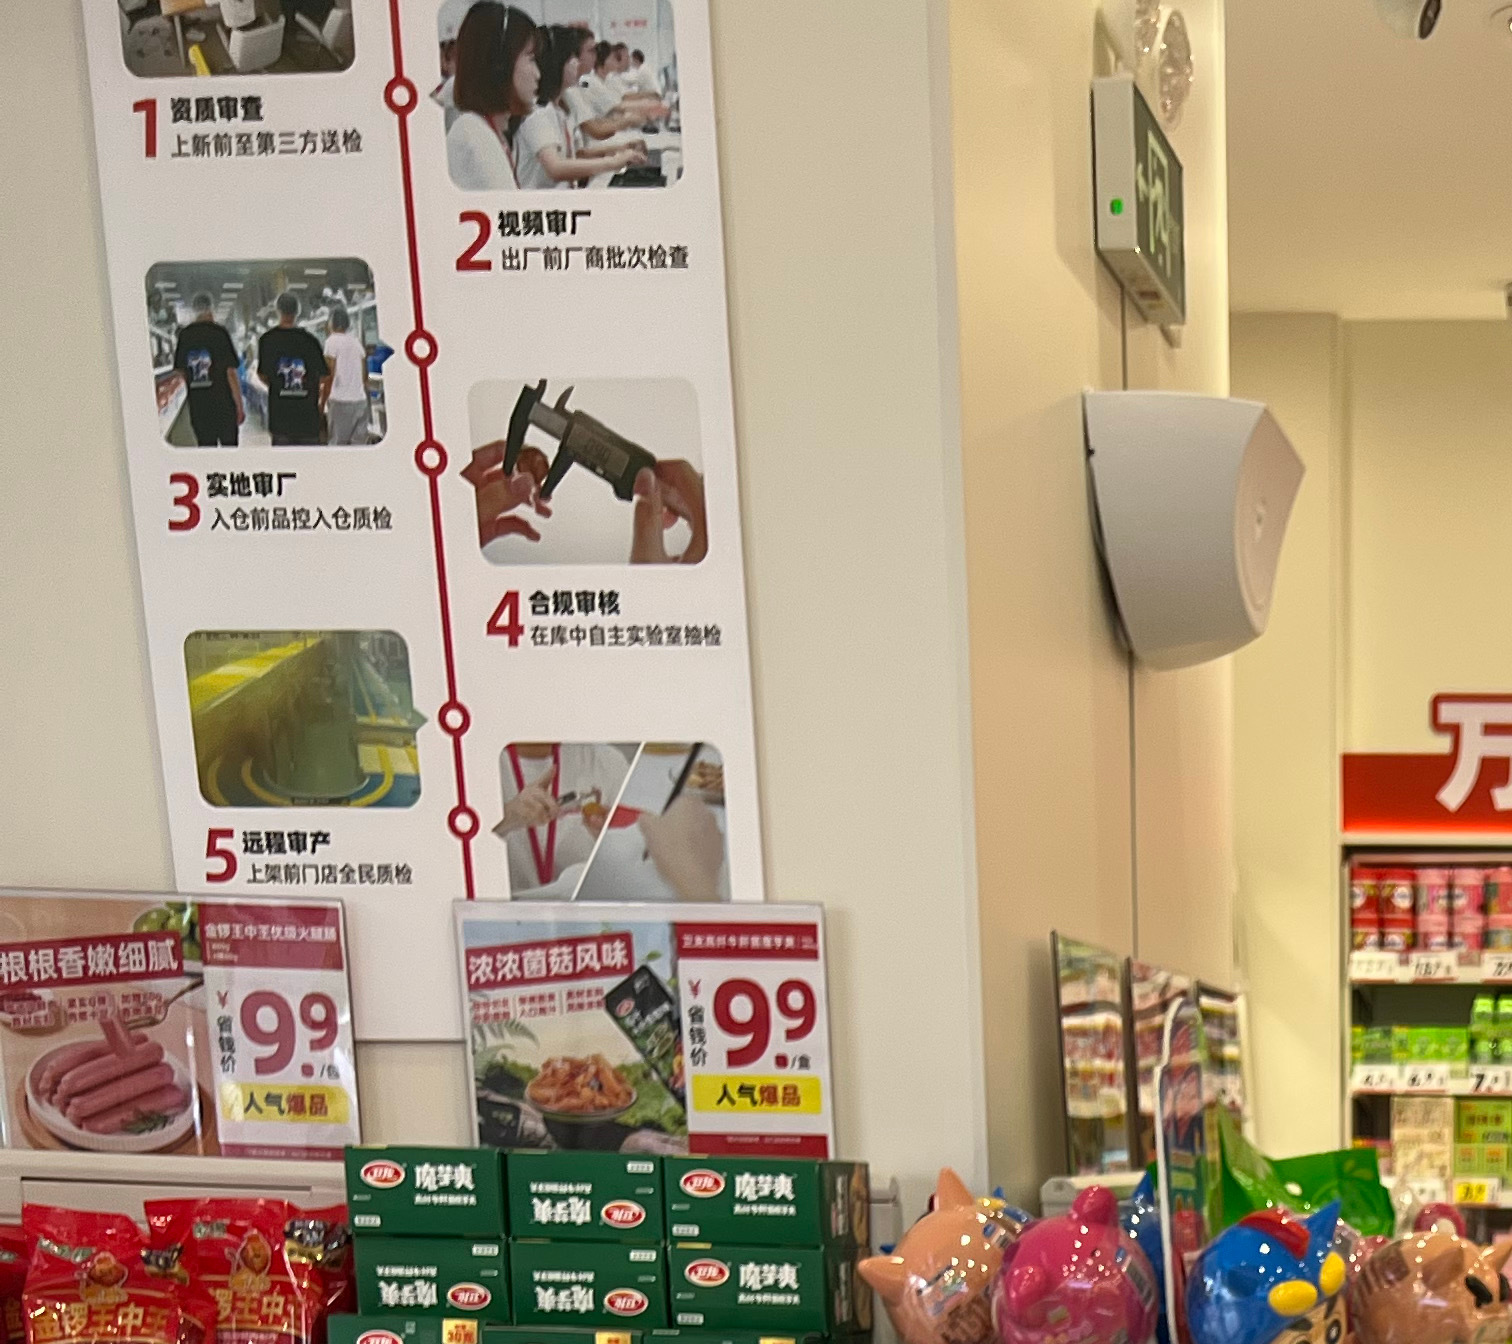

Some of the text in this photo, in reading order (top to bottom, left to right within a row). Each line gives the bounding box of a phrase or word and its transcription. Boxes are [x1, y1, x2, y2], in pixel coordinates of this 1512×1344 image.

[170, 95, 264, 124] 资质审查
[133, 98, 157, 158] 1
[170, 129, 363, 157] 上新前至第三方送检
[498, 210, 591, 238] 视频审厂
[455, 210, 493, 272] 2
[501, 243, 690, 272] 出厂前厂商批次检查
[206, 471, 297, 498] 实地审厂
[167, 472, 202, 533] 3
[209, 507, 393, 532] 入仓前品控入仓质检
[529, 590, 621, 617] 合规审核
[486, 589, 525, 648] 4
[530, 623, 722, 648] 在库中自主实验室抽检
[206, 828, 237, 883] 5
[243, 830, 330, 854] 远程审产
[247, 863, 412, 884] 上架前门店全民质检
[0, 939, 179, 984] 根根香嫩细腻
[469, 938, 629, 985] 浓浓菌菇风味
[240, 990, 339, 1077] 9.9
[714, 977, 816, 1069] 9.9
[243, 1092, 328, 1117] 人气爆品
[717, 1083, 801, 1107] 人气爆品
